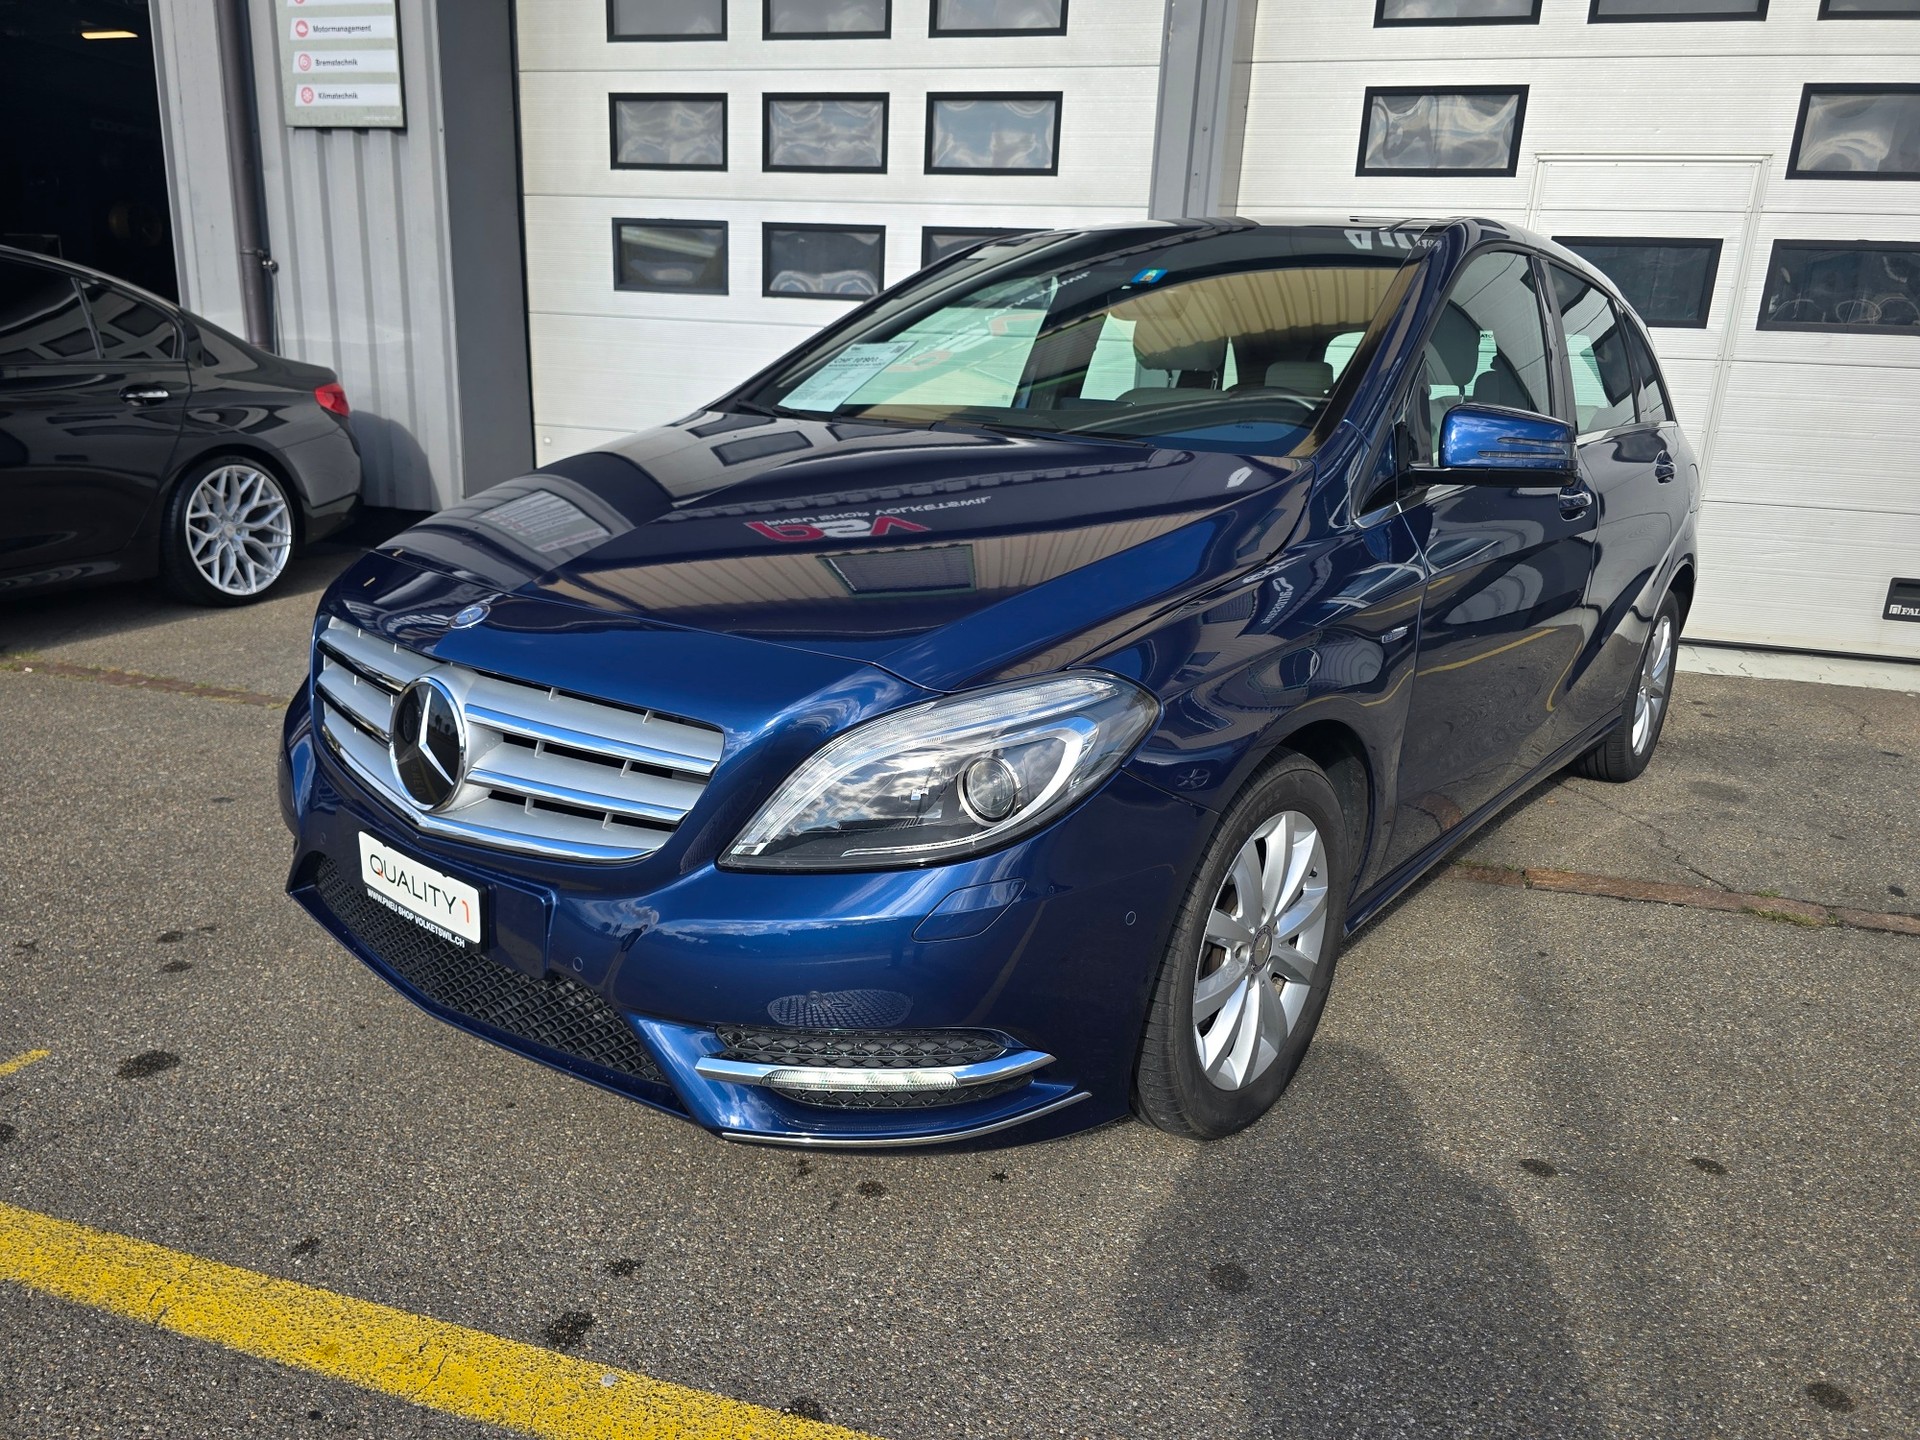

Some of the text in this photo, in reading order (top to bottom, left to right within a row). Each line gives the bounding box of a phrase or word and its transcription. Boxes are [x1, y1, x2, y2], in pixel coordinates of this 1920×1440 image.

[313, 25, 371, 33] Motormanagement
[370, 854, 456, 914] QUALITY
[398, 906, 413, 920] SHOP
